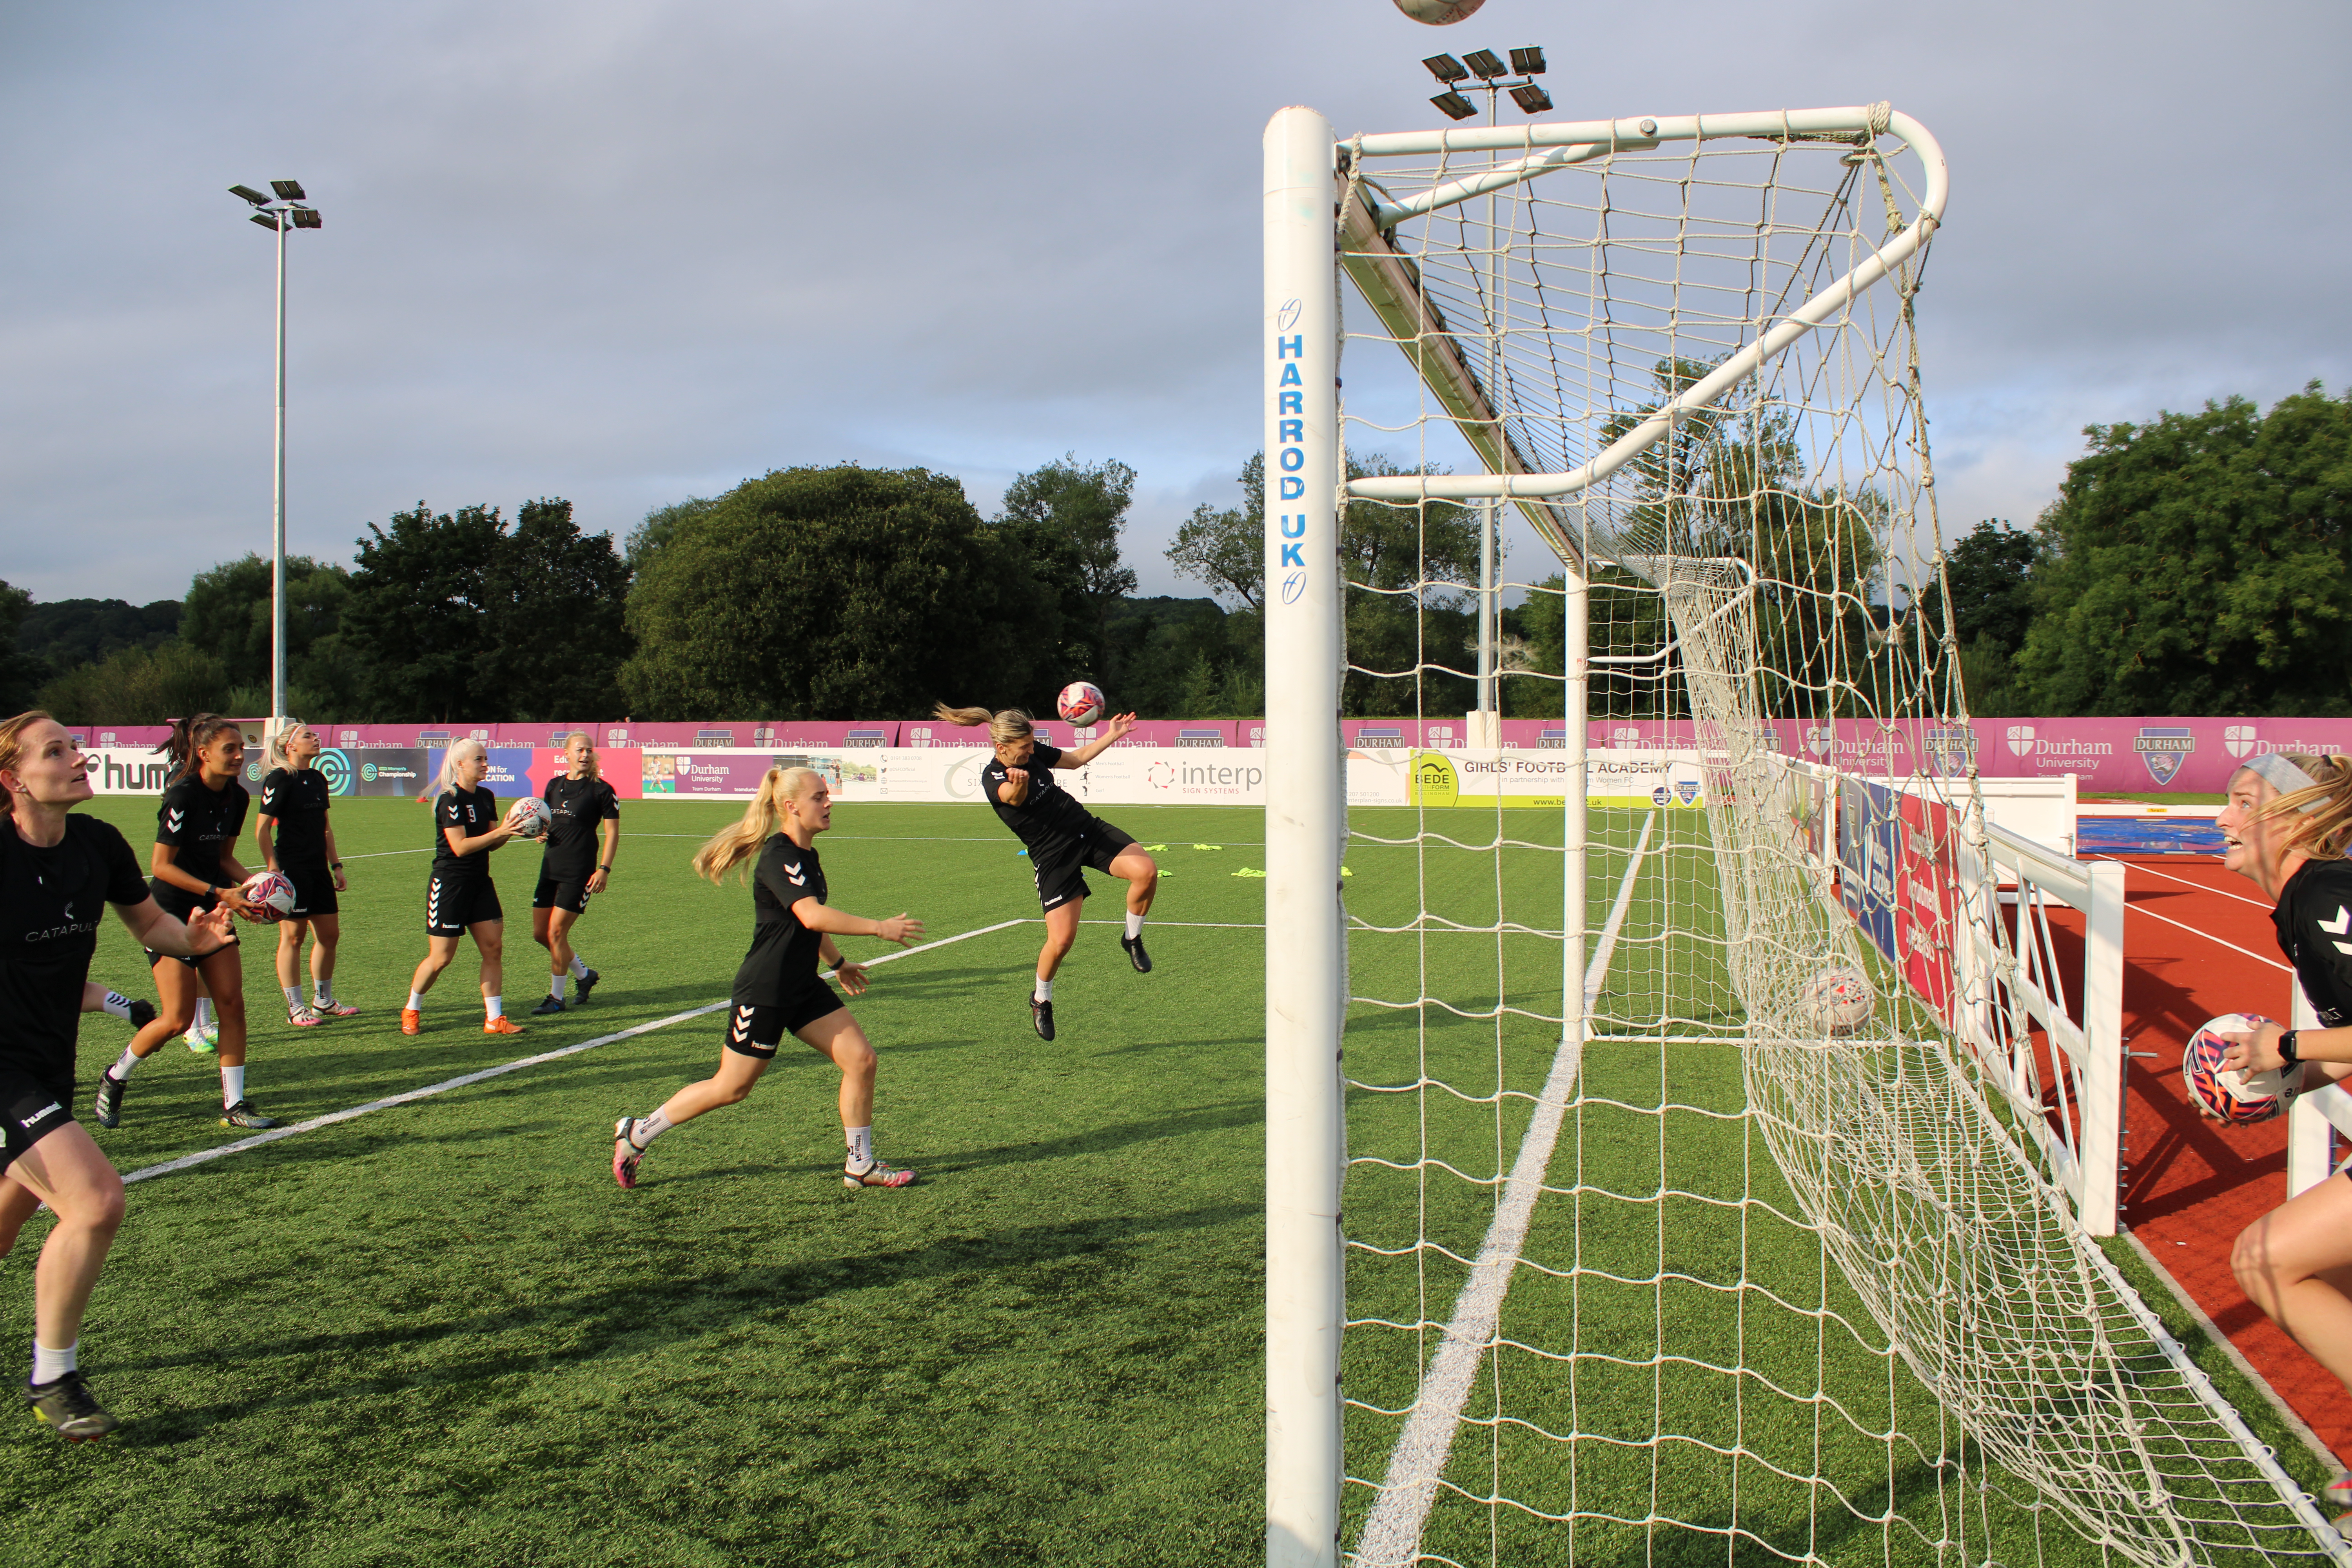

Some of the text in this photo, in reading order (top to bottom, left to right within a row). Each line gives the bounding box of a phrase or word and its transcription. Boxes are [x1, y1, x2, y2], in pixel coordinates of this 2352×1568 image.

[1278, 335, 1306, 567] HARROD UK
[358, 739, 403, 748] Durham
[488, 739, 535, 748] Durham
[627, 739, 679, 748] Durham
[695, 739, 732, 747] DURHAM
[774, 738, 828, 748] Durham
[846, 739, 884, 747] DURHAM
[932, 738, 989, 748] Durham
[1177, 739, 1221, 747] DURHAM
[1357, 739, 1402, 748] DURHAM
[1539, 740, 1566, 748] DURH
[1833, 739, 1904, 754] Durham
[2035, 739, 2113, 755] Durham
[2137, 740, 2192, 750] DURHAM
[2256, 740, 2341, 756] Durham
[1517, 762, 1594, 773] FOOTBL
[1598, 762, 1673, 773] ACADEMY
[2036, 757, 2100, 770] University
[105, 754, 169, 789] hum
[691, 764, 730, 775] Durham
[1183, 761, 1262, 791] interp
[1415, 774, 1449, 784] BEDE
[468, 808, 476, 823] 9
[1045, 895, 1063, 906] hummel
[751, 1040, 777, 1050] hummel
[20, 1101, 62, 1128] hummel
